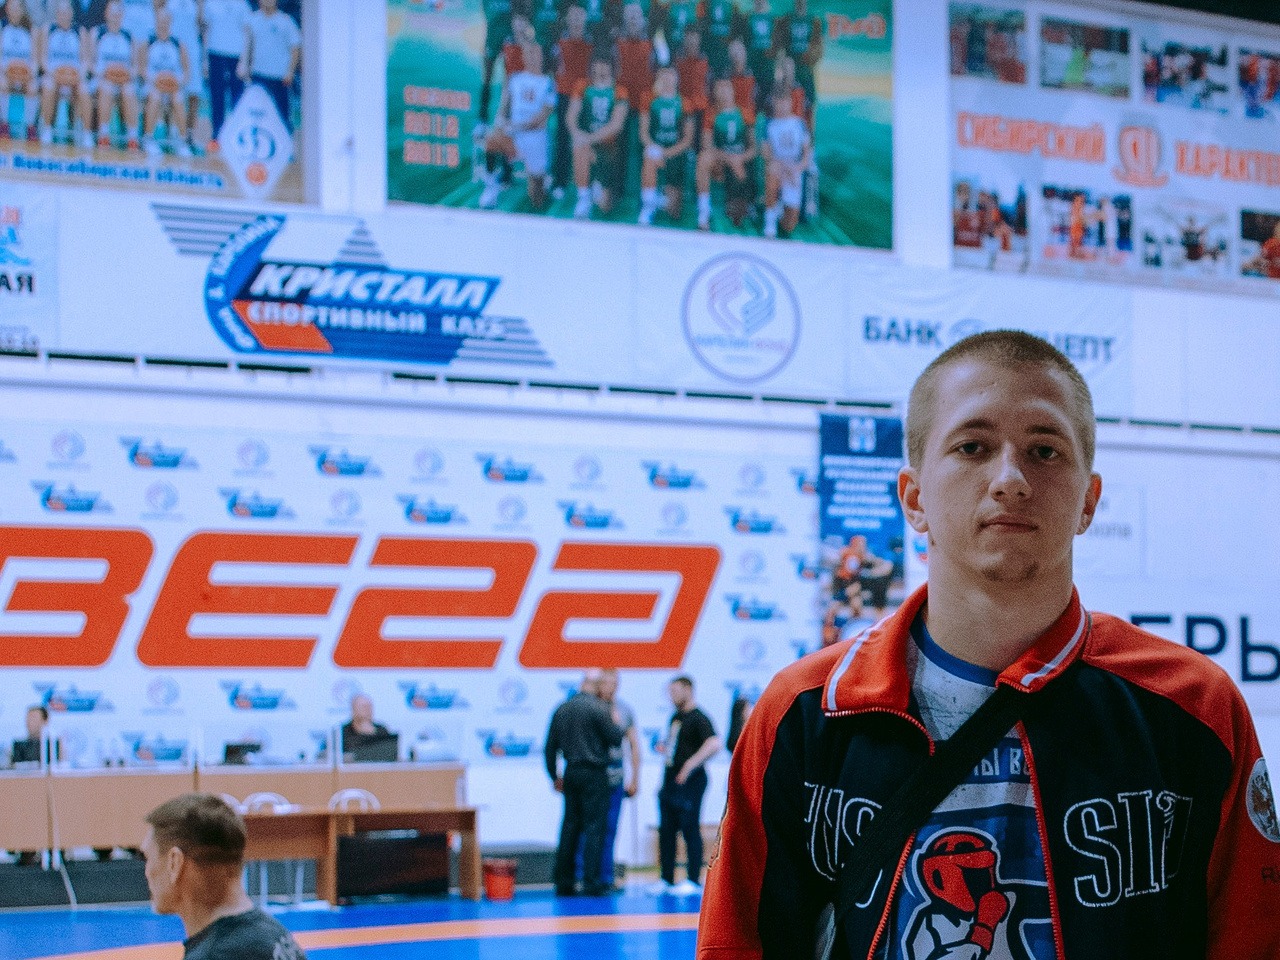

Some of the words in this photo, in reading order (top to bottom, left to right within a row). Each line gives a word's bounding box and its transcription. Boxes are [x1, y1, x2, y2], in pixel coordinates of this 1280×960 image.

[249, 262, 489, 309] КРИСТАЛЛ
[247, 301, 427, 334] СПОРТИВНЫЙ
[863, 315, 943, 347] БАНК
